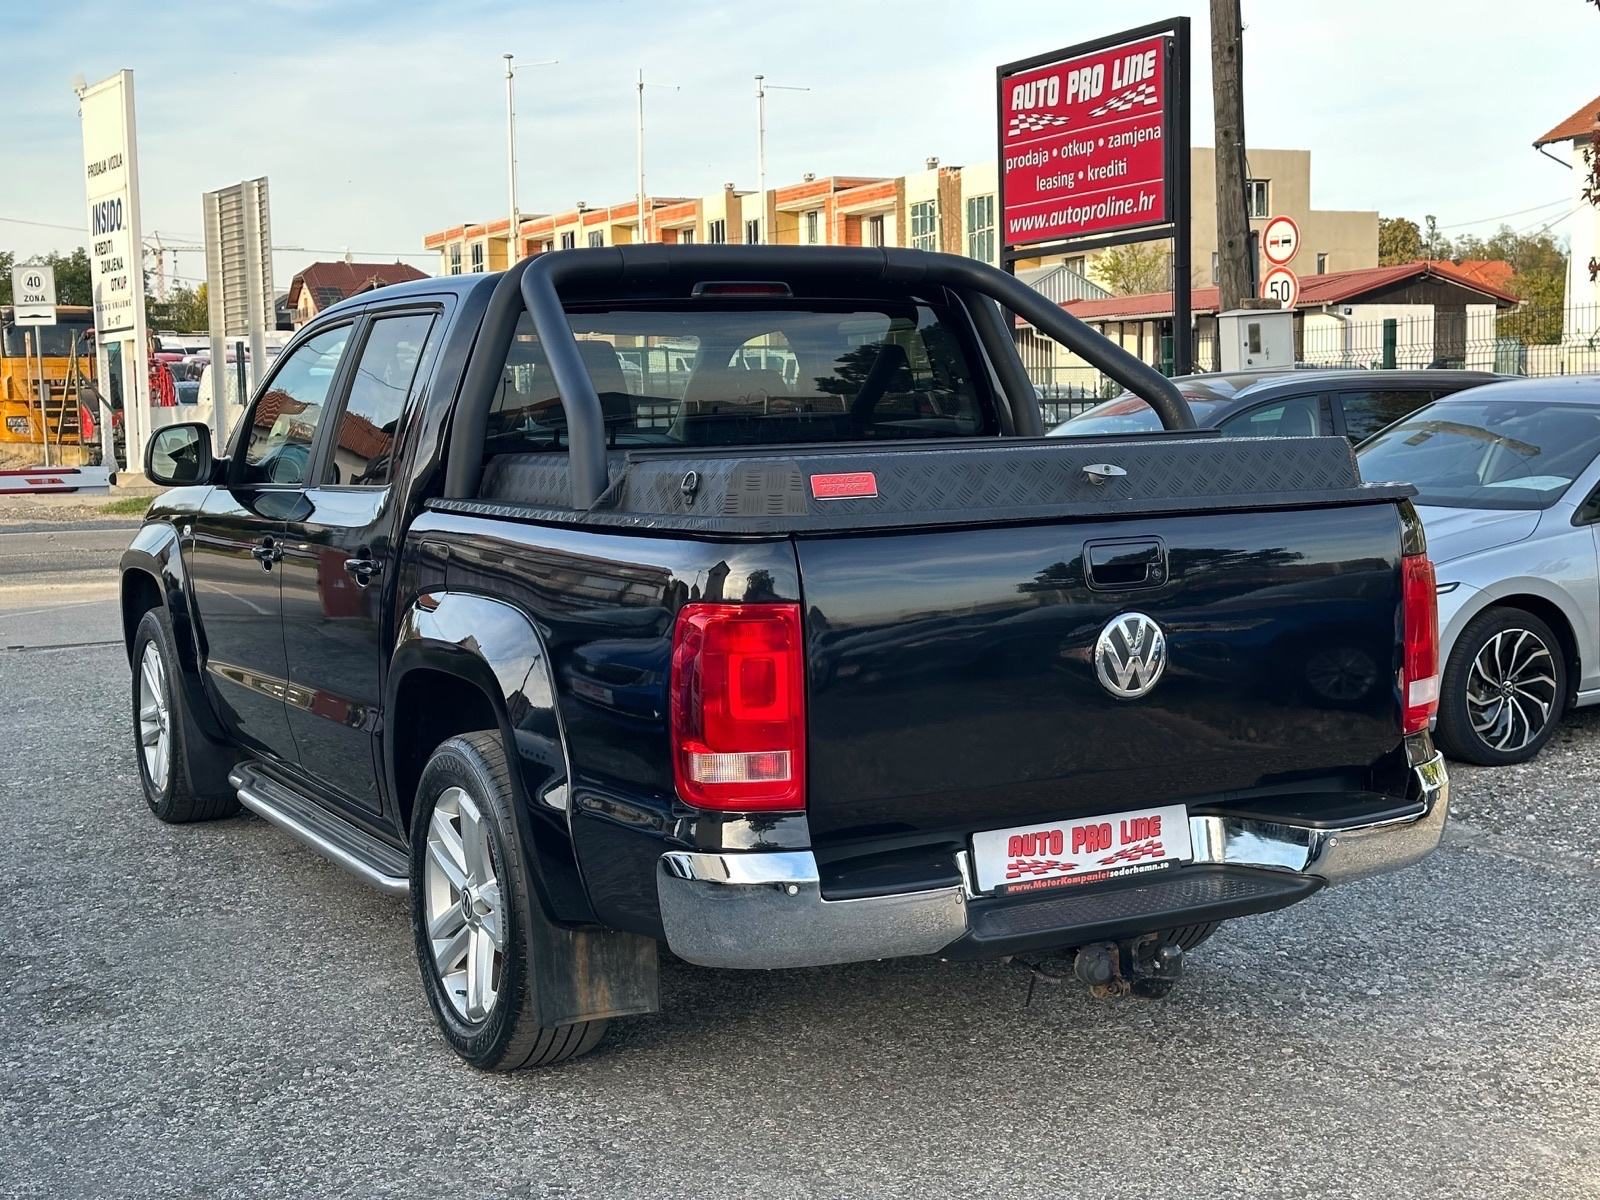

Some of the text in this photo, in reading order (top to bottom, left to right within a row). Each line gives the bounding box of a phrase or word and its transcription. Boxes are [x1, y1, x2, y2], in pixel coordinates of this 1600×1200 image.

[1011, 49, 1157, 111] AUTO PRO LINE
[1005, 125, 1161, 174] prodaja otkup zamjena
[87, 159, 107, 179] PRODAJA
[1036, 158, 1127, 192] leasing krediti
[92, 197, 123, 237] INSIDO
[1009, 190, 1156, 233] www.autoproline.hr
[94, 239, 114, 257] KREDITI
[100, 256, 124, 274] ZAMJENA
[26, 276, 41, 288] 40
[110, 275, 127, 292] OTKUP
[1270, 280, 1290, 302] 50
[23, 294, 46, 303] ZONA
[1007, 814, 1162, 858] AUTO PRO LINE
